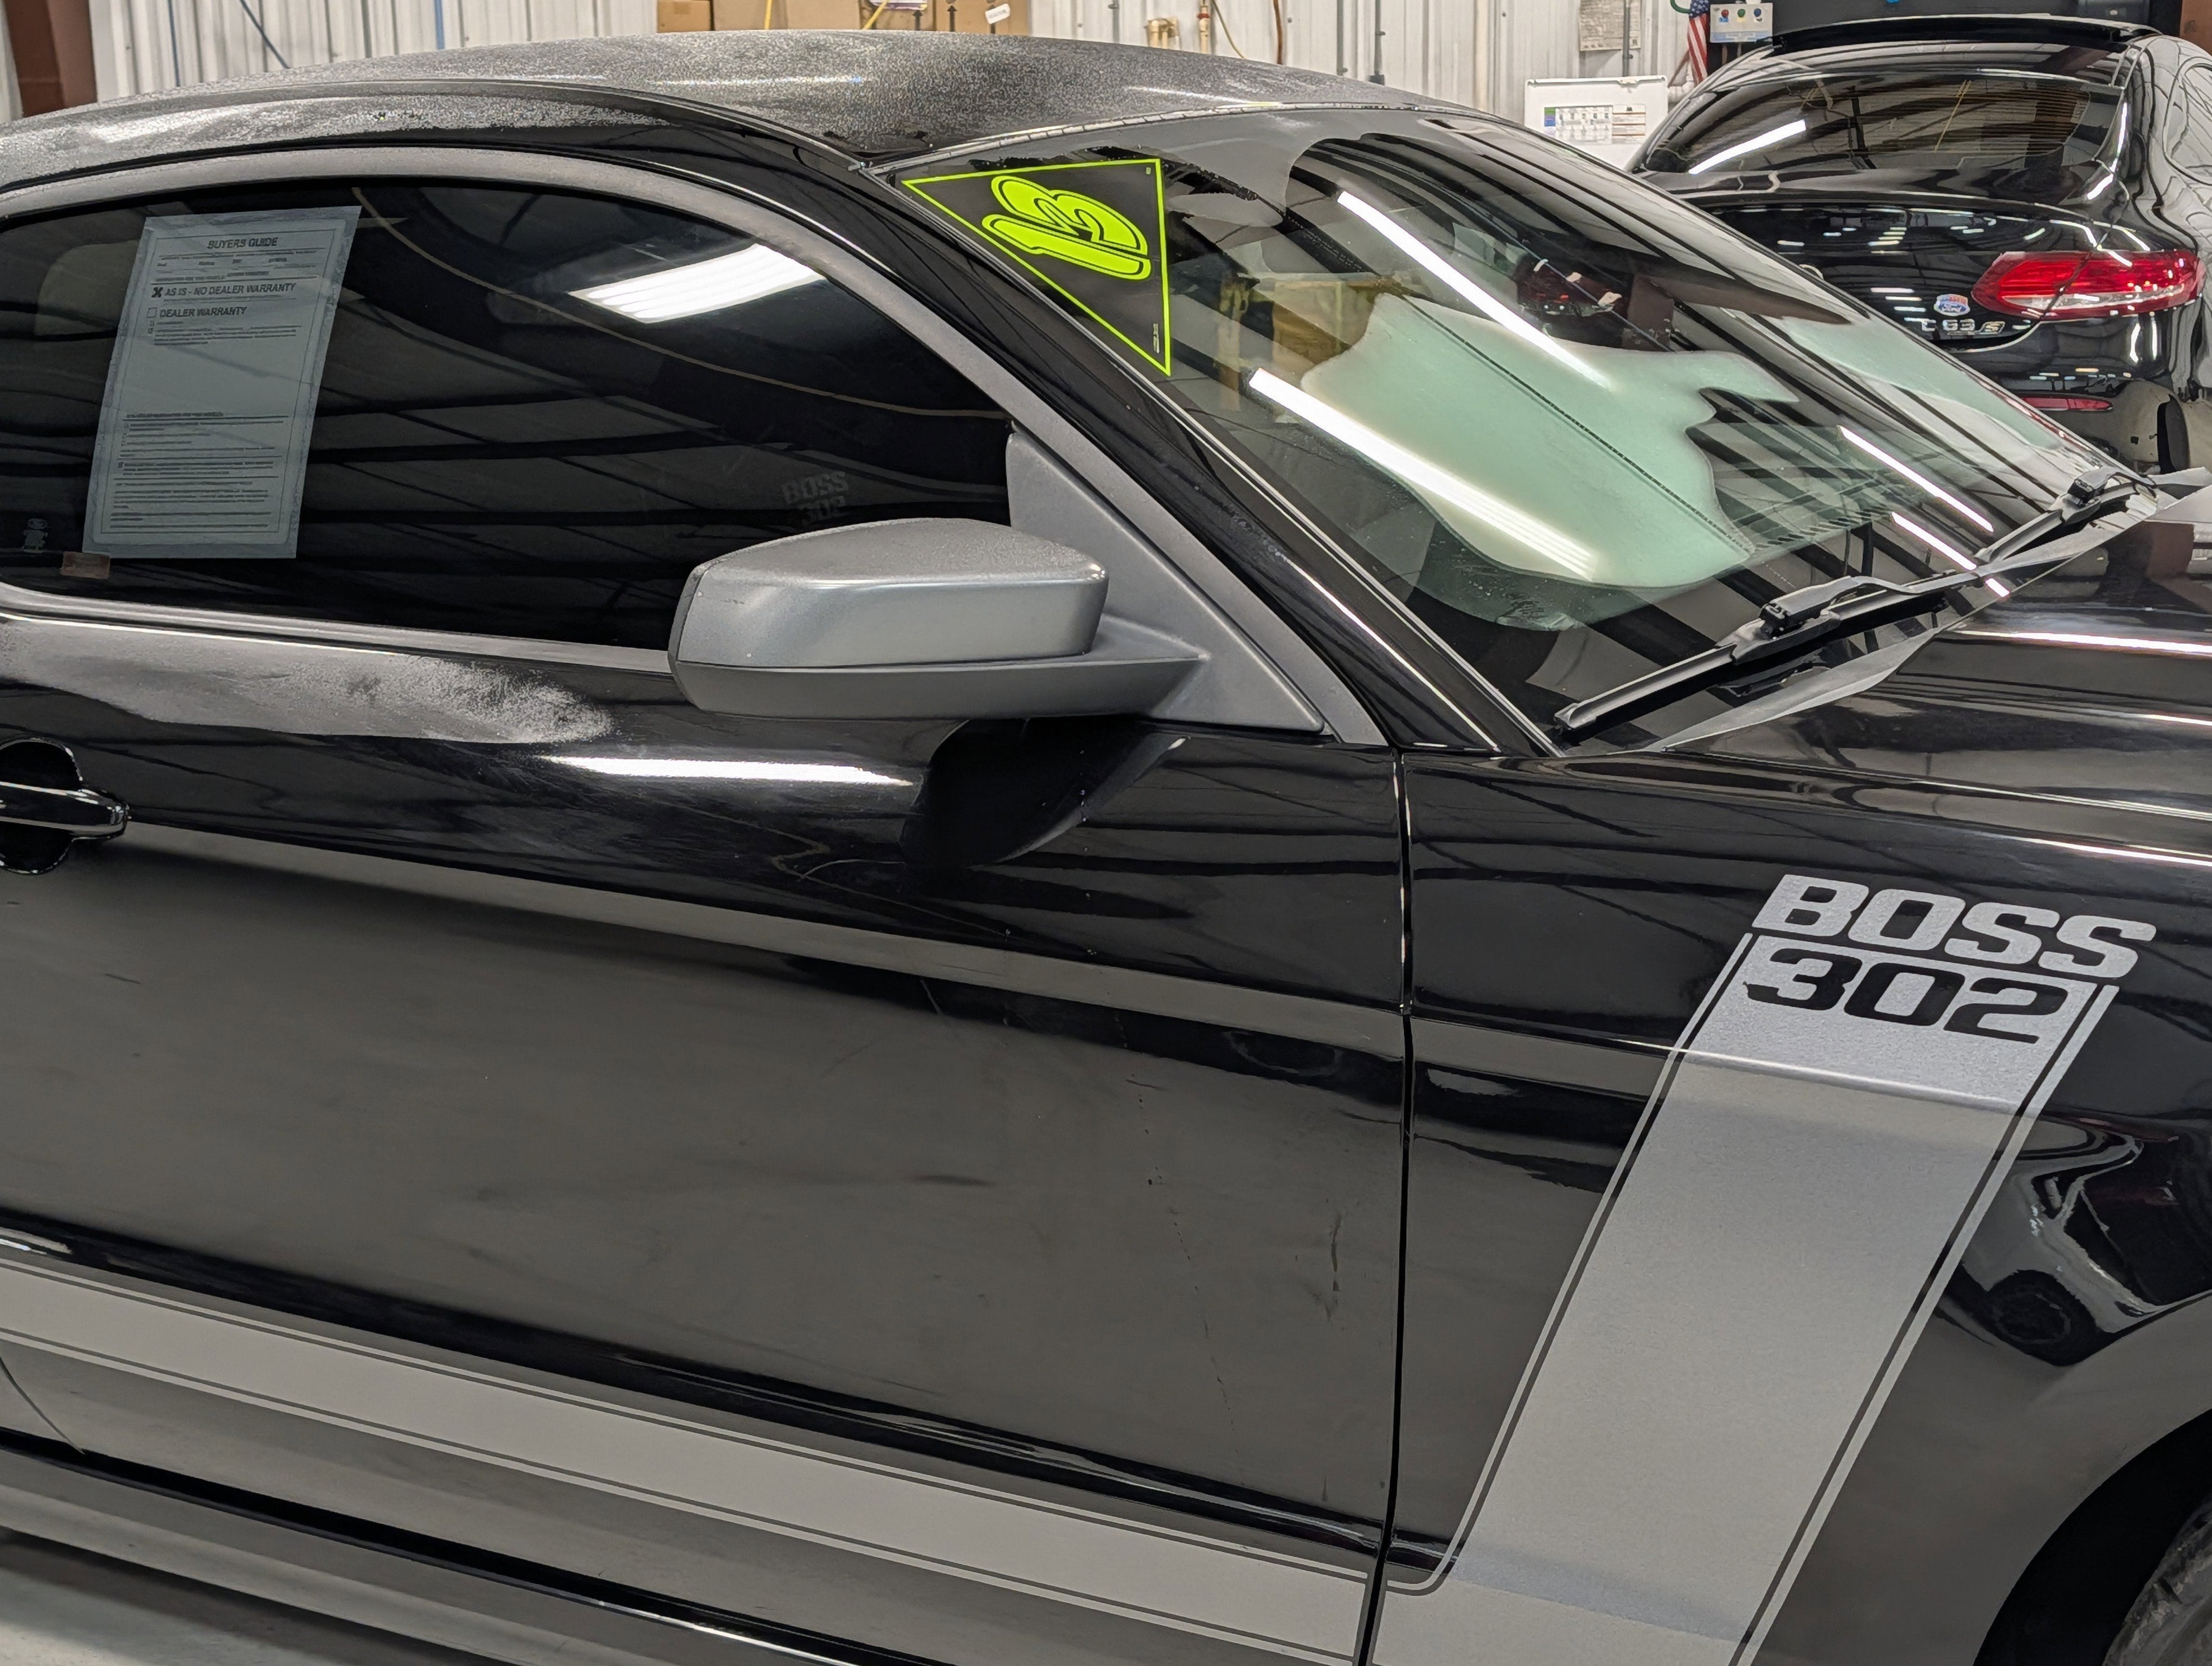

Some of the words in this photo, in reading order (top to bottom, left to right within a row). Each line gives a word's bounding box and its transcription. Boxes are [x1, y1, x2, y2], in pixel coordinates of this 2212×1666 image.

[207, 239, 246, 249] BUYERS
[248, 238, 279, 247] GUIDE
[164, 287, 176, 296] AS
[194, 286, 207, 295] NO
[209, 285, 244, 295] DEALER
[247, 283, 297, 292] WARRANTY
[159, 307, 195, 317] DEALER
[197, 306, 247, 316] WARRANTY
[1752, 874, 2157, 978] BOSS
[1742, 948, 2069, 1044] 302
